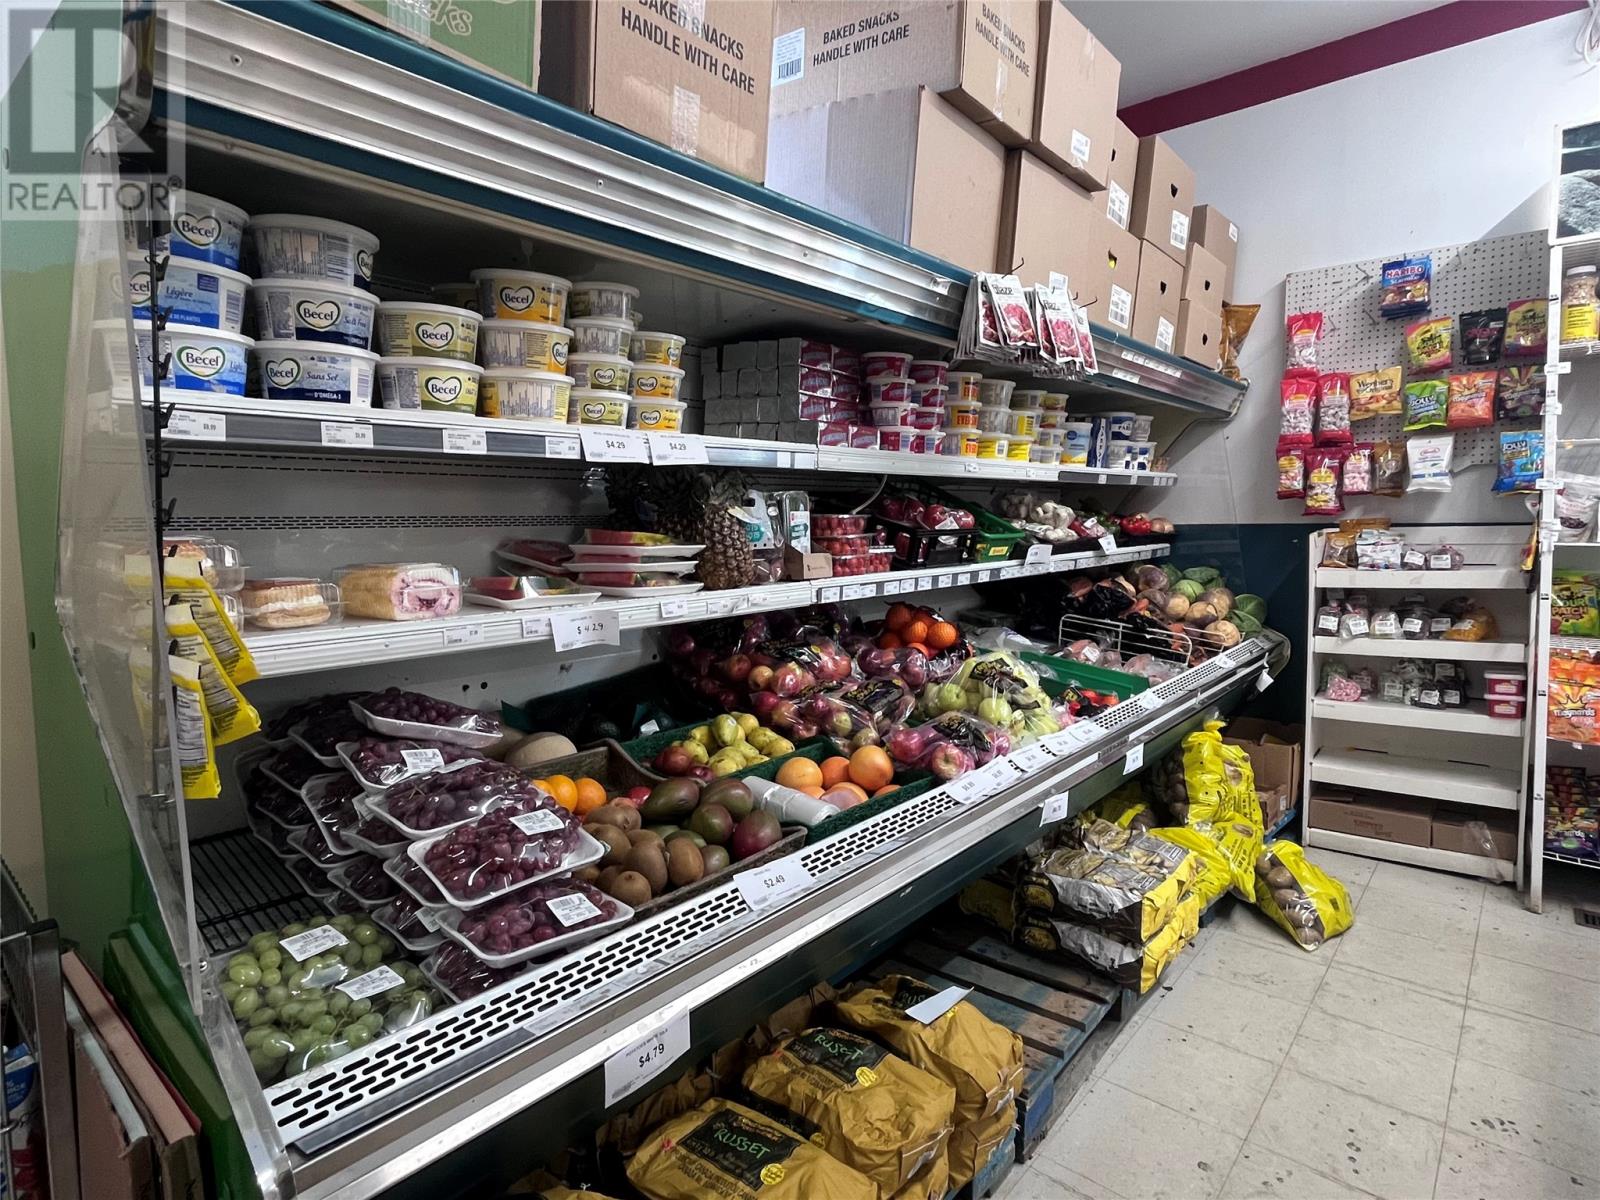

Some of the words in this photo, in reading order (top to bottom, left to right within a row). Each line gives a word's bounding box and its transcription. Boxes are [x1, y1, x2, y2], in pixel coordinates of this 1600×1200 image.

[823, 23, 856, 45] BAKED
[857, 10, 901, 33] SNACKS
[691, 16, 745, 61] SNACKS
[812, 43, 851, 67] HANDLE
[853, 34, 879, 54] WITH
[881, 24, 911, 45] CARE
[621, 6, 681, 56] HANDLE
[684, 41, 719, 76] WITH
[721, 62, 756, 95] CARE
[975, 17, 999, 50] HANDLE
[1015, 55, 1030, 78] CARE
[182, 220, 217, 239] Becel
[1385, 264, 1425, 280] HARIBO
[165, 286, 194, 299] Légère
[504, 293, 529, 305] Becel
[303, 307, 334, 322] Becel
[421, 329, 449, 341] Becel
[185, 351, 220, 367] Becel
[266, 368, 294, 379] Becel
[306, 370, 323, 382] Sans
[325, 372, 339, 382] Sel
[431, 383, 457, 395] Becel
[586, 406, 603, 416] Becel
[605, 439, 626, 450] $4.29
[1503, 440, 1527, 451] JOLLY
[763, 874, 785, 888] $2.49
[639, 1043, 665, 1068] $4.79
[714, 1128, 771, 1159] RUSSET
